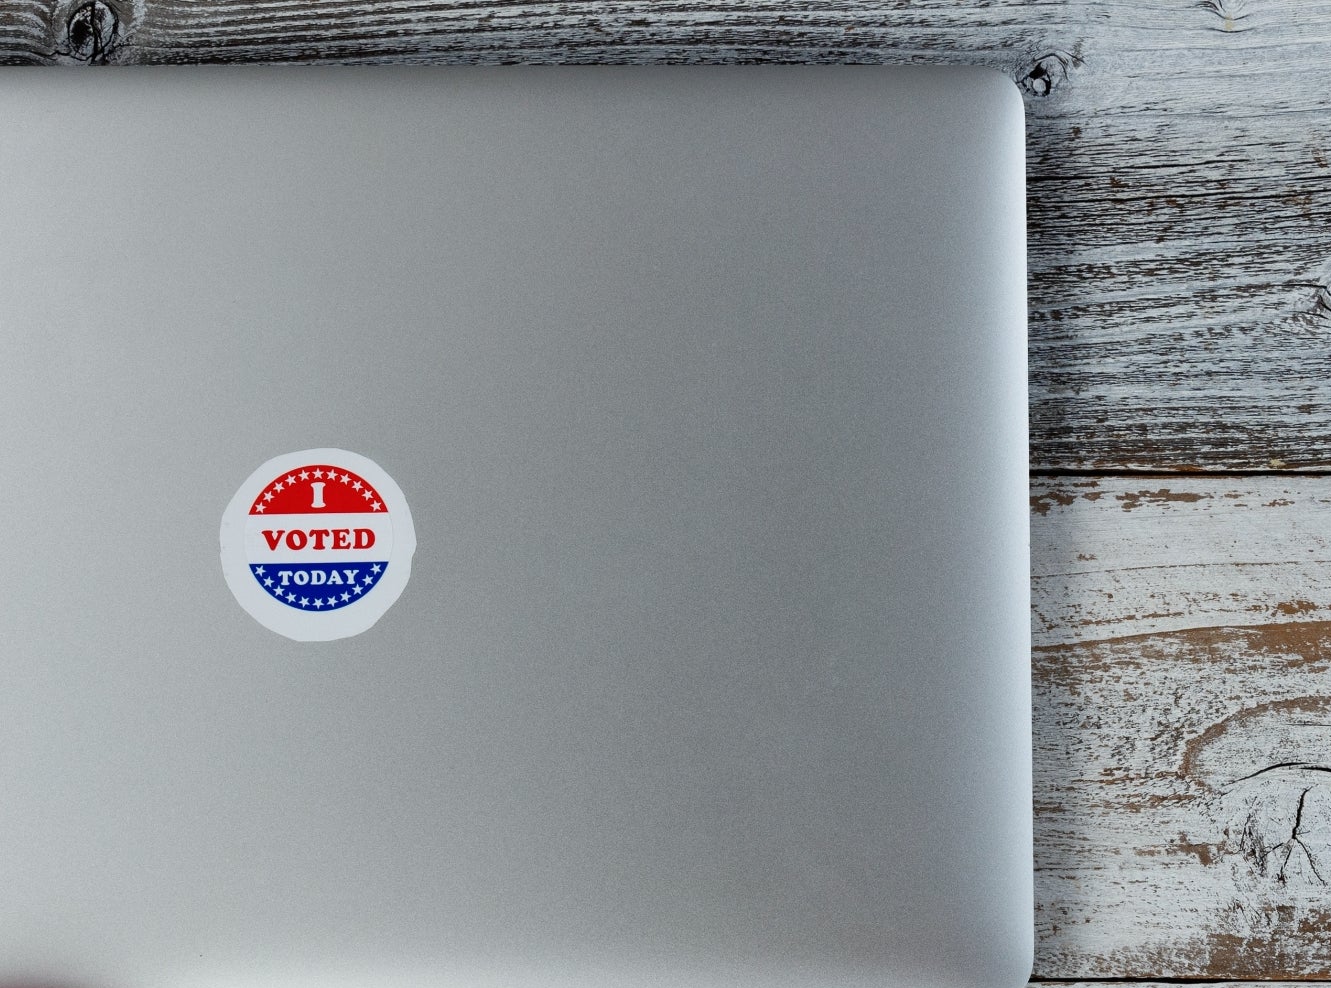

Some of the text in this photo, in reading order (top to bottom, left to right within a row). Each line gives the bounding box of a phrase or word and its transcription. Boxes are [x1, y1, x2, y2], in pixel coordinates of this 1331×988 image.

[310, 482, 327, 508] I
[261, 528, 376, 551] VOTED
[278, 569, 360, 586] TODAY
